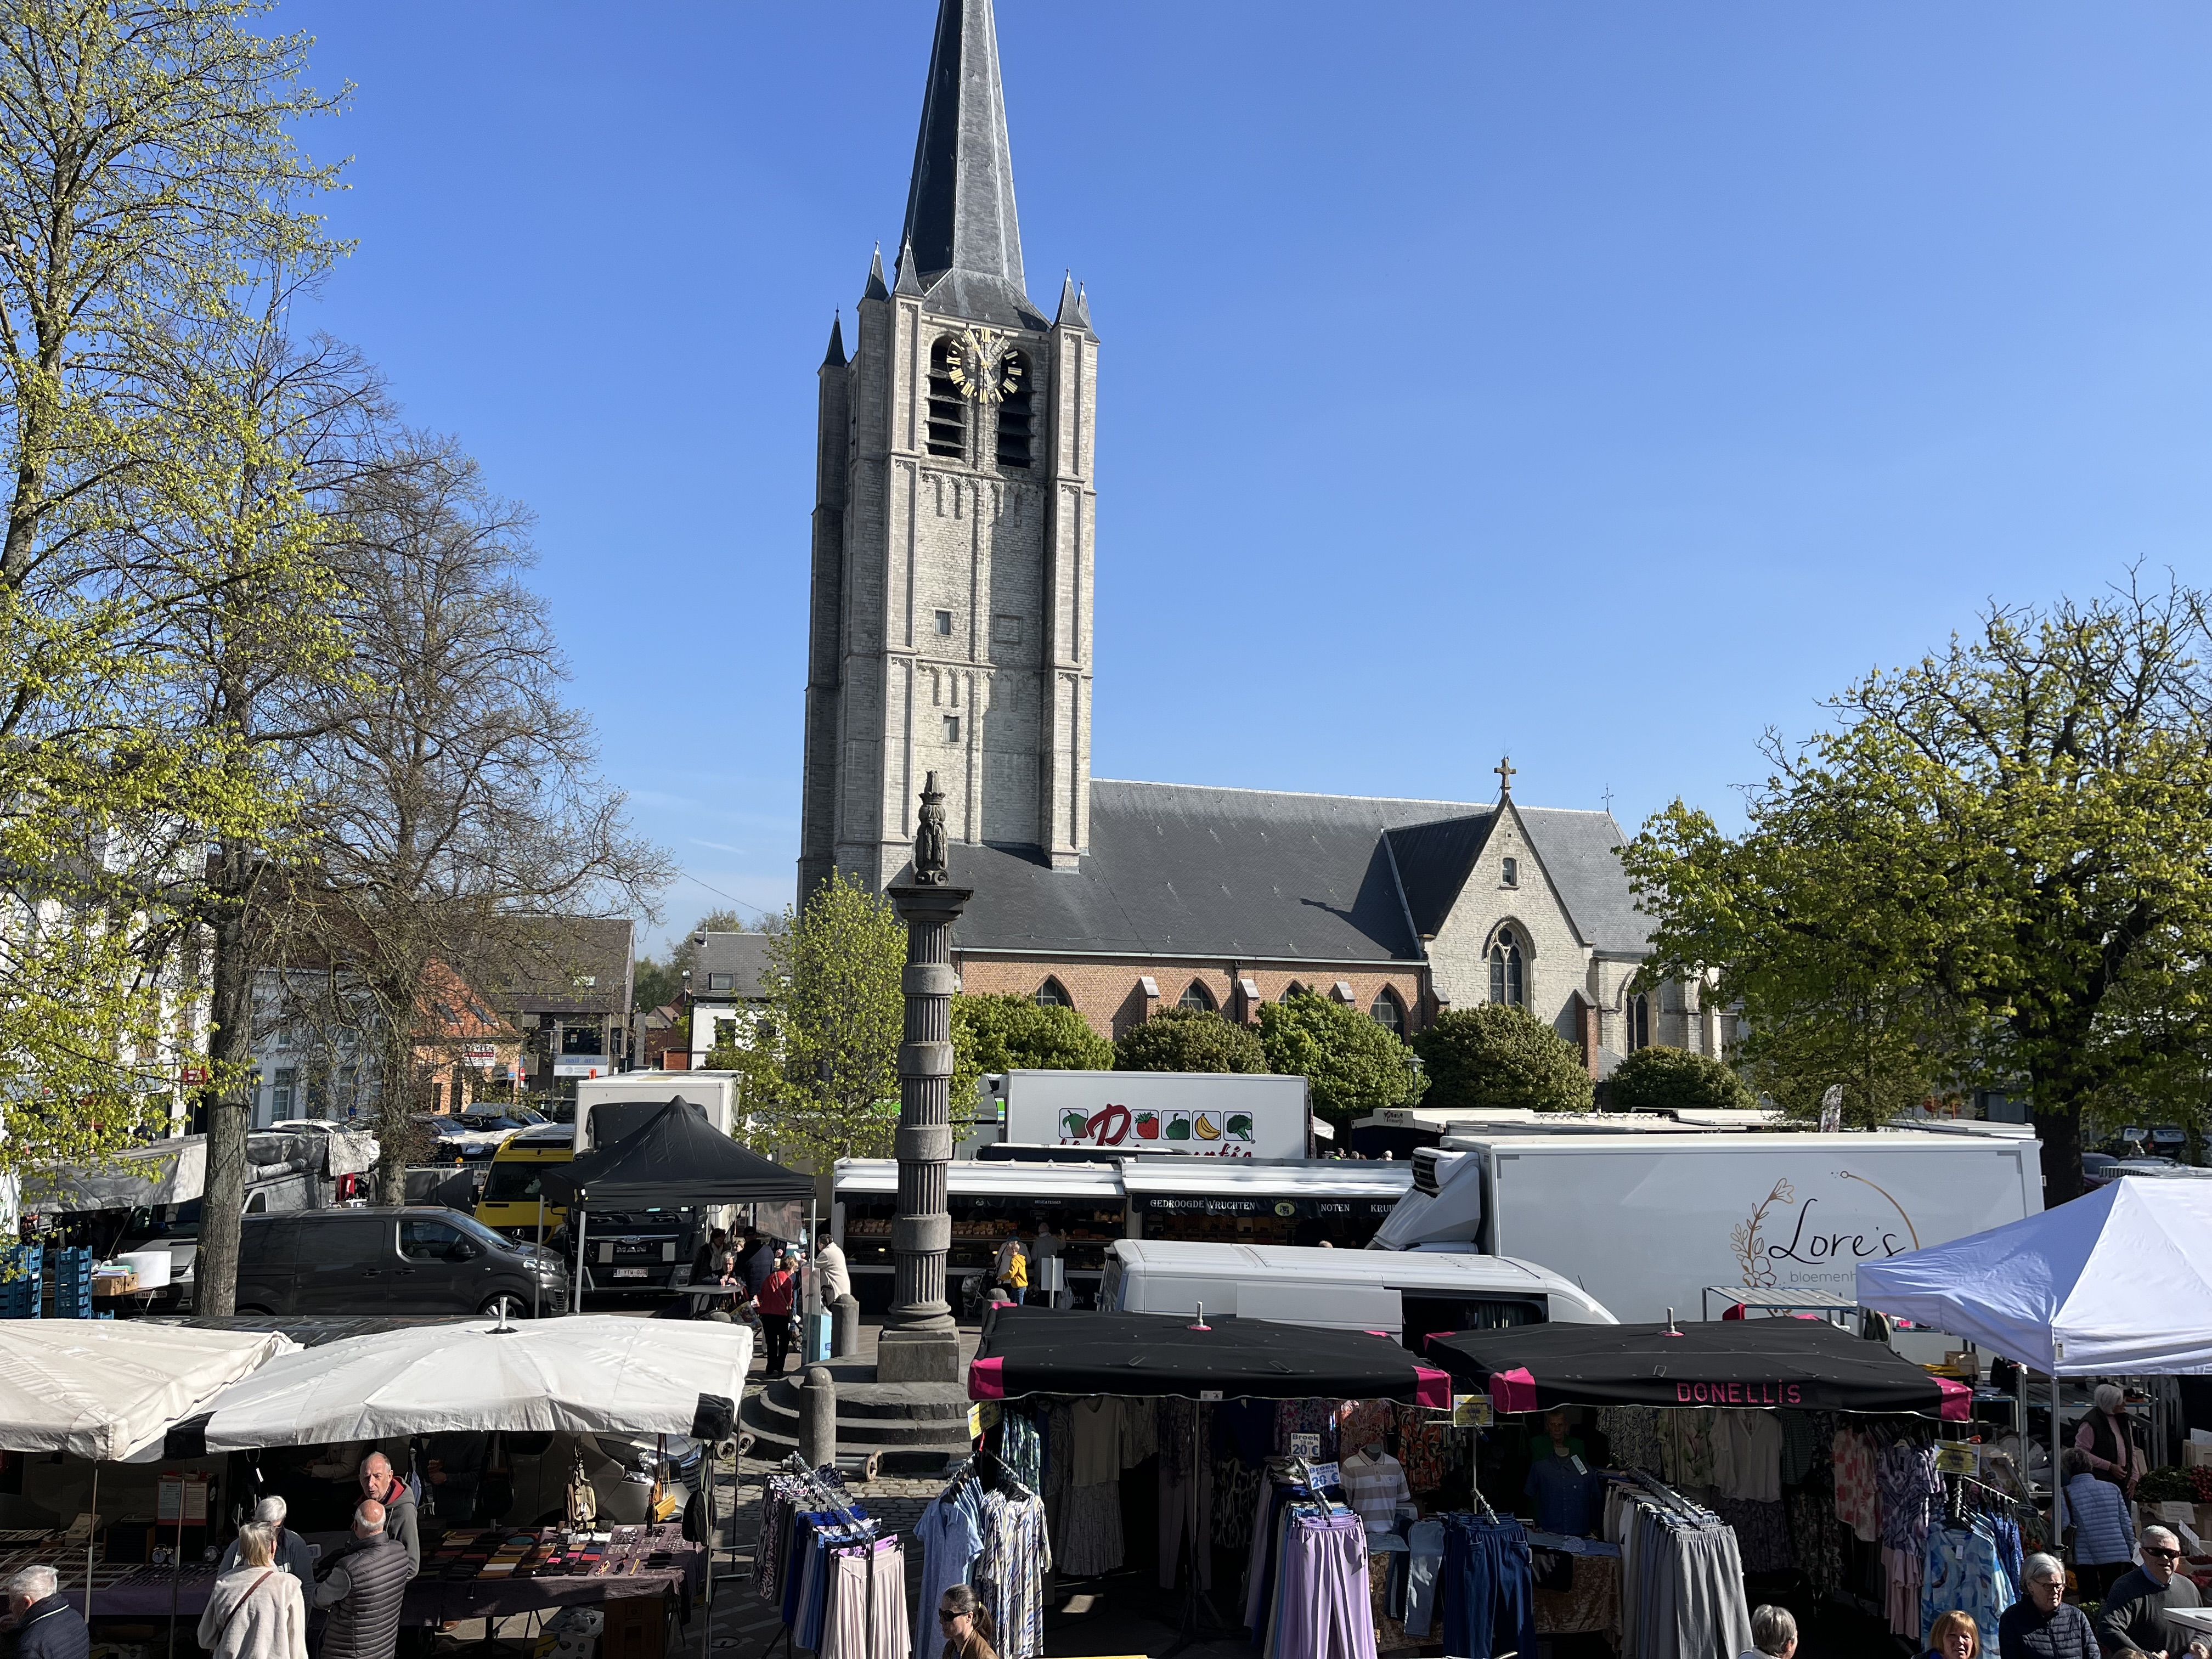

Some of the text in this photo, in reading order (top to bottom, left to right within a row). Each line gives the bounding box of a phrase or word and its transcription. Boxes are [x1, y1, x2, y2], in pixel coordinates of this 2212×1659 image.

[1150, 1199, 1205, 1208] GEDROOGDE
[1209, 1200, 1255, 1210] VRUCHTEN
[1321, 1204, 1350, 1212] NOTEN
[1768, 1198, 1906, 1264] Lore's
[1293, 1444, 1319, 1455] 20 €
[1310, 1463, 1337, 1474] Broek
[1311, 1472, 1340, 1488] 20 €
